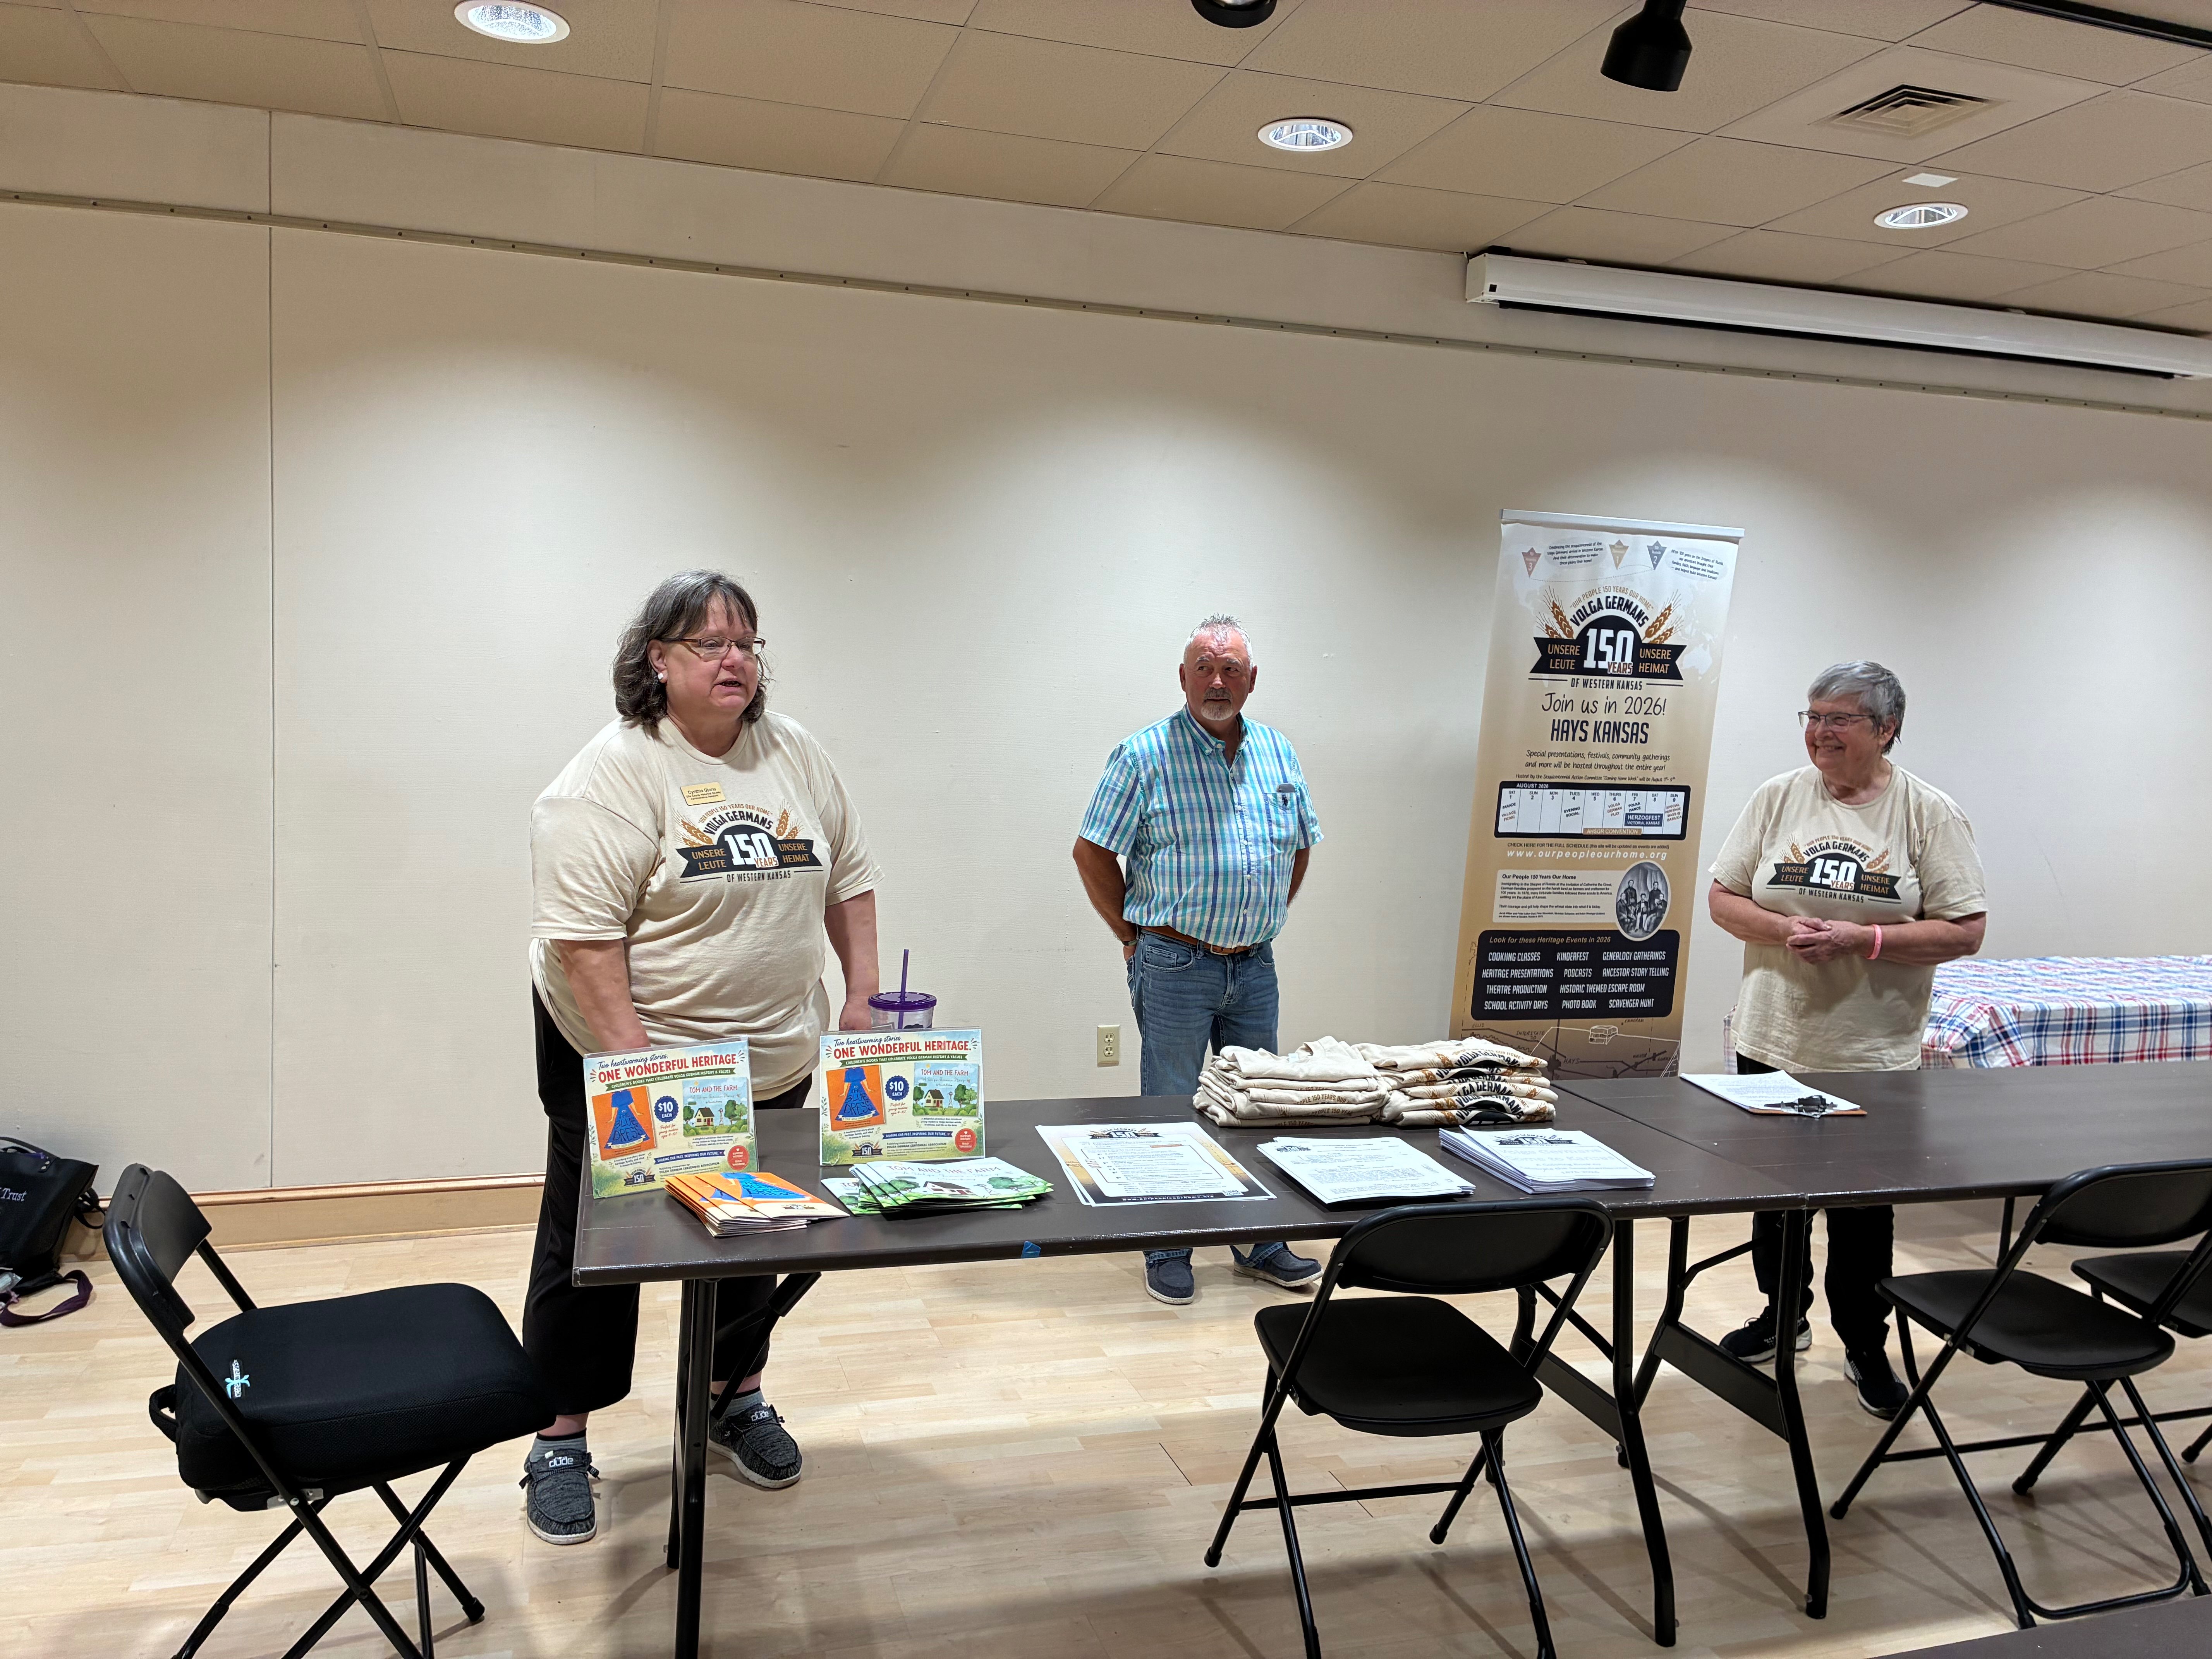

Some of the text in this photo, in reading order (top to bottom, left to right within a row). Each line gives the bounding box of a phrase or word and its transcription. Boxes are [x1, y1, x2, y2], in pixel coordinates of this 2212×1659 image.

[1582, 587, 1601, 601] PEOPLE
[1613, 586, 1628, 594] YEARS
[1629, 590, 1639, 600] OUR
[1570, 596, 1649, 627] VOLGA GERMANS
[1547, 644, 1580, 655] UNSERE
[1583, 629, 1634, 669] 150
[1639, 649, 1672, 659] UNSERE
[1550, 659, 1575, 670] LEUTE
[1607, 662, 1633, 675] YEARS
[1638, 663, 1670, 673] HEIMAT
[1571, 678, 1643, 690] OF WESTERN KANSAS
[1542, 692, 1667, 716] Join us in 2026!
[1551, 719, 1649, 744] HAYS KANSAS
[1526, 750, 1670, 762] Special presentations, festivals, community gatherings
[1594, 763, 1623, 771] throughout
[1653, 764, 1666, 772] year!
[706, 807, 720, 817] PEOPLE
[703, 811, 774, 835] VOLGA GERMANS
[724, 833, 775, 866] 150
[778, 843, 808, 852] UNSERE
[1803, 841, 1870, 862] VOLGA GERMANS
[692, 848, 726, 860] UNSERE
[782, 854, 809, 863] HEIMAT
[1507, 850, 1667, 860] www.ourpeopleourhome.org
[698, 859, 727, 871] LEUTE
[754, 856, 778, 867] YEARS
[1781, 866, 1809, 874] UNSERE
[1809, 858, 1857, 885] 150
[727, 871, 791, 883] OF WESTERN KANSAS
[1781, 874, 1803, 883] LEUTE
[1861, 874, 1890, 884] UNSERE
[1831, 880, 1854, 890] YEARS
[1860, 883, 1890, 895] HEIMAT
[1808, 889, 1837, 899] WESTERN
[1839, 893, 1864, 903] KANSAS
[1517, 952, 1540, 961] CLASSES
[1557, 952, 1589, 961] KINDERFEST
[1602, 951, 1666, 961] GENEALOGY GATHERINGS
[1482, 969, 1554, 978] HERITAGE PRESENTATIONS
[1564, 969, 1592, 977] PODCASTS
[1602, 967, 1669, 977] ANCESTOR STORY TELLING
[1487, 984, 1547, 994] THEATRE PRODUCTION
[1559, 983, 1645, 993] HISTORIC THEMED ESCAPE ROOM
[1484, 1000, 1548, 1010] SCHOOL ACTIVITY DAYS
[1562, 1000, 1597, 1009] PHOTO BOOK
[1609, 999, 1654, 1008] SCAVENGER HUNT
[846, 1037, 883, 1046] heartwarming
[834, 1040, 972, 1059] ONE WONDERFUL HERITAGE.
[598, 1053, 668, 1070] Two heartwarming stories.
[598, 1053, 739, 1083] ONE WONDERFUL HERITAGE.
[889, 1081, 904, 1091] $10
[658, 1101, 673, 1113] $10
[844, 1100, 873, 1115] DRESS
[613, 1125, 643, 1142] DRESS
[0, 1188, 27, 1201] Trust
[549, 1456, 574, 1468] dude
